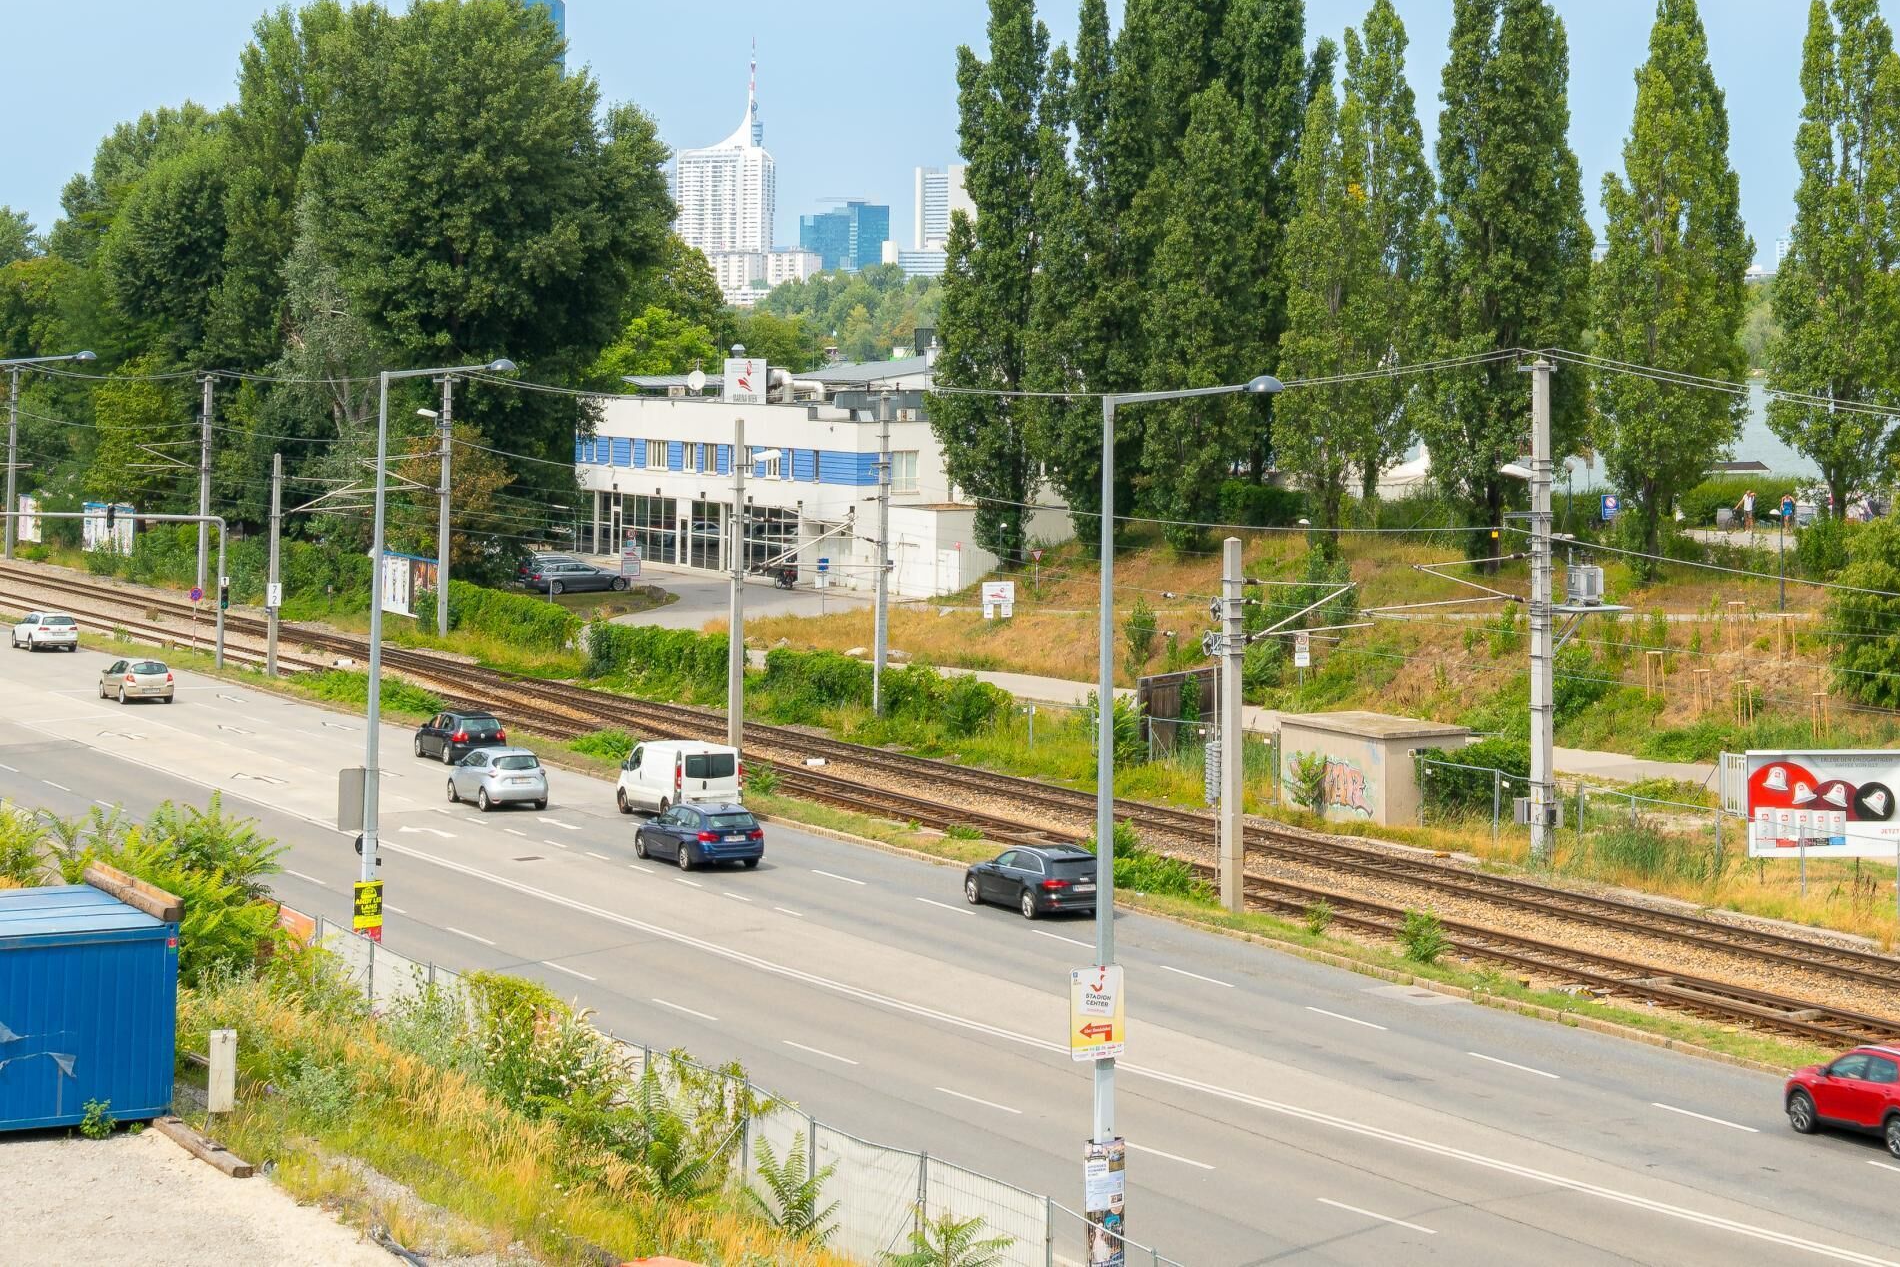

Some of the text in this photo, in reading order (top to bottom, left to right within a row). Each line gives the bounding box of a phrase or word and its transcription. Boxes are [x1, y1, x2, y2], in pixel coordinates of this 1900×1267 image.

[272, 585, 278, 594] 7
[272, 595, 278, 604] 2
[1085, 993, 1112, 1001] STADION
